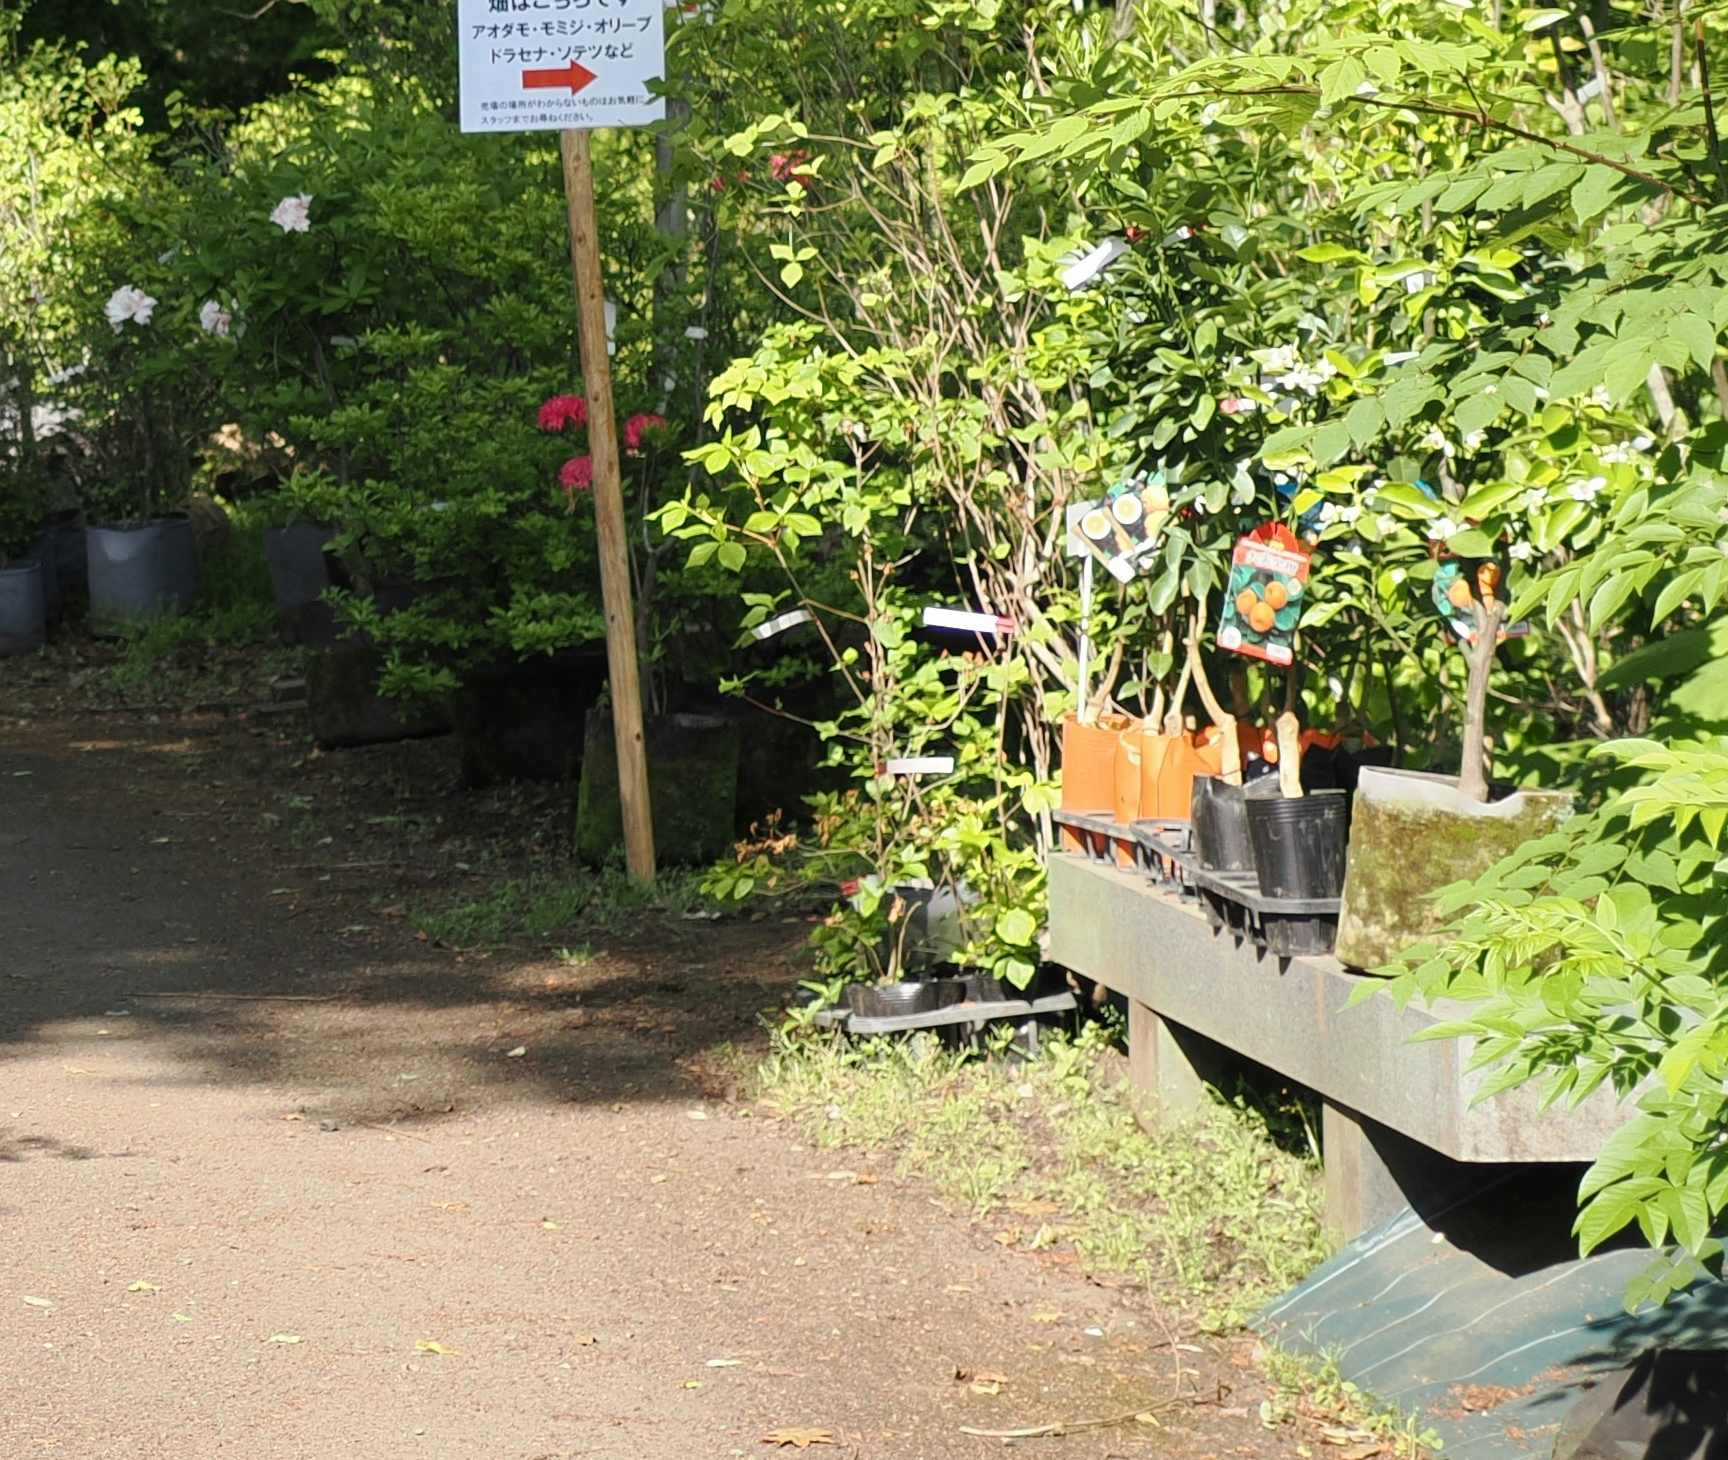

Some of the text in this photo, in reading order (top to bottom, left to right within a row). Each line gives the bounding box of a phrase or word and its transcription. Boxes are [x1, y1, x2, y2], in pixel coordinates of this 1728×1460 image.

[490, 42, 635, 64] ドラセナ・ソテツなど
